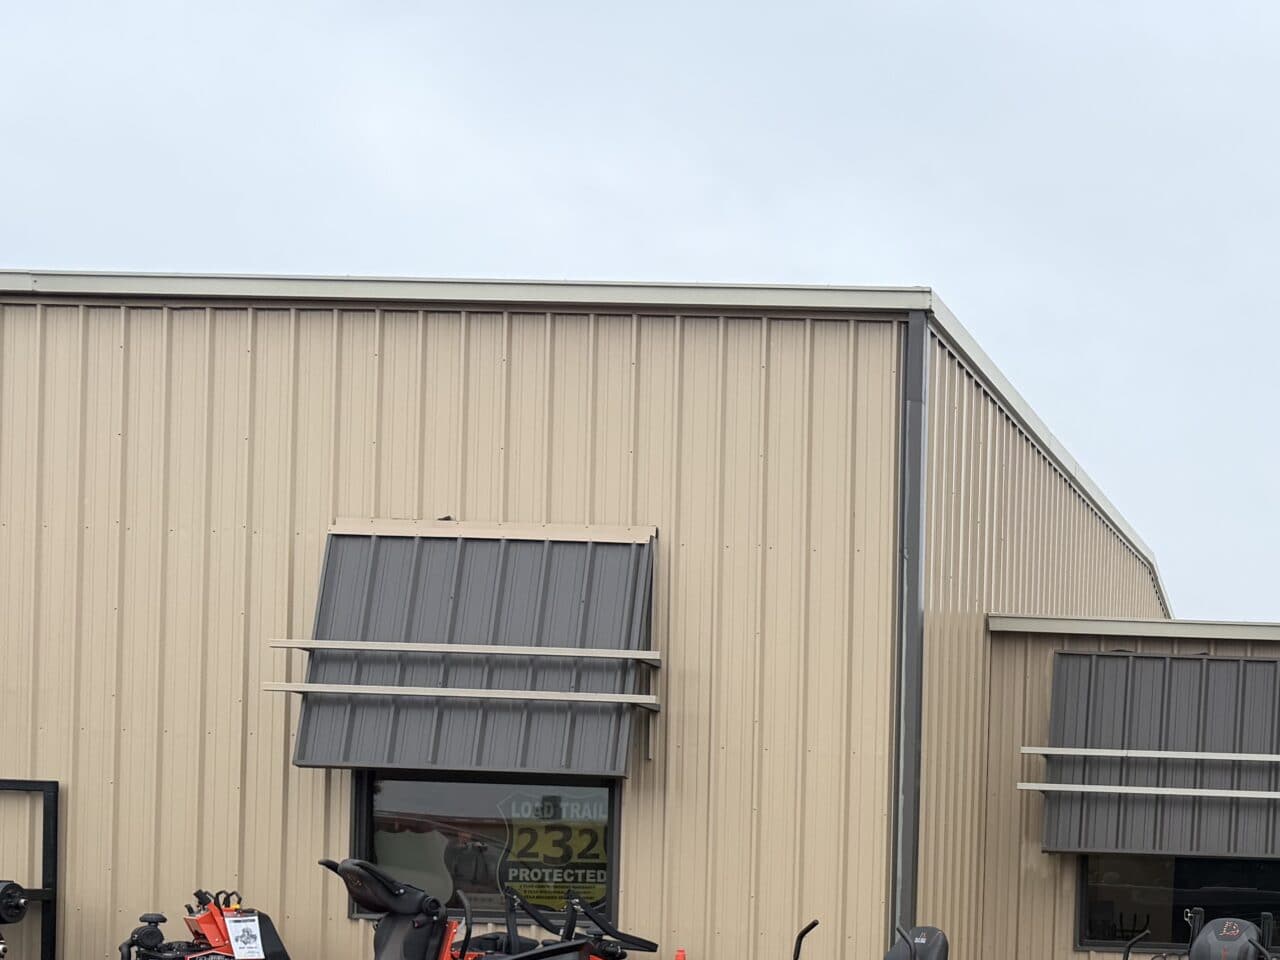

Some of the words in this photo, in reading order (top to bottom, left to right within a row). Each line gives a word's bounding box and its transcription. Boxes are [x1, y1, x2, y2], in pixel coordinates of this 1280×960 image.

[512, 800, 555, 818] LOAD
[560, 801, 608, 819] TRAIL
[516, 823, 599, 867] 232
[508, 868, 607, 882] PROTECTED
